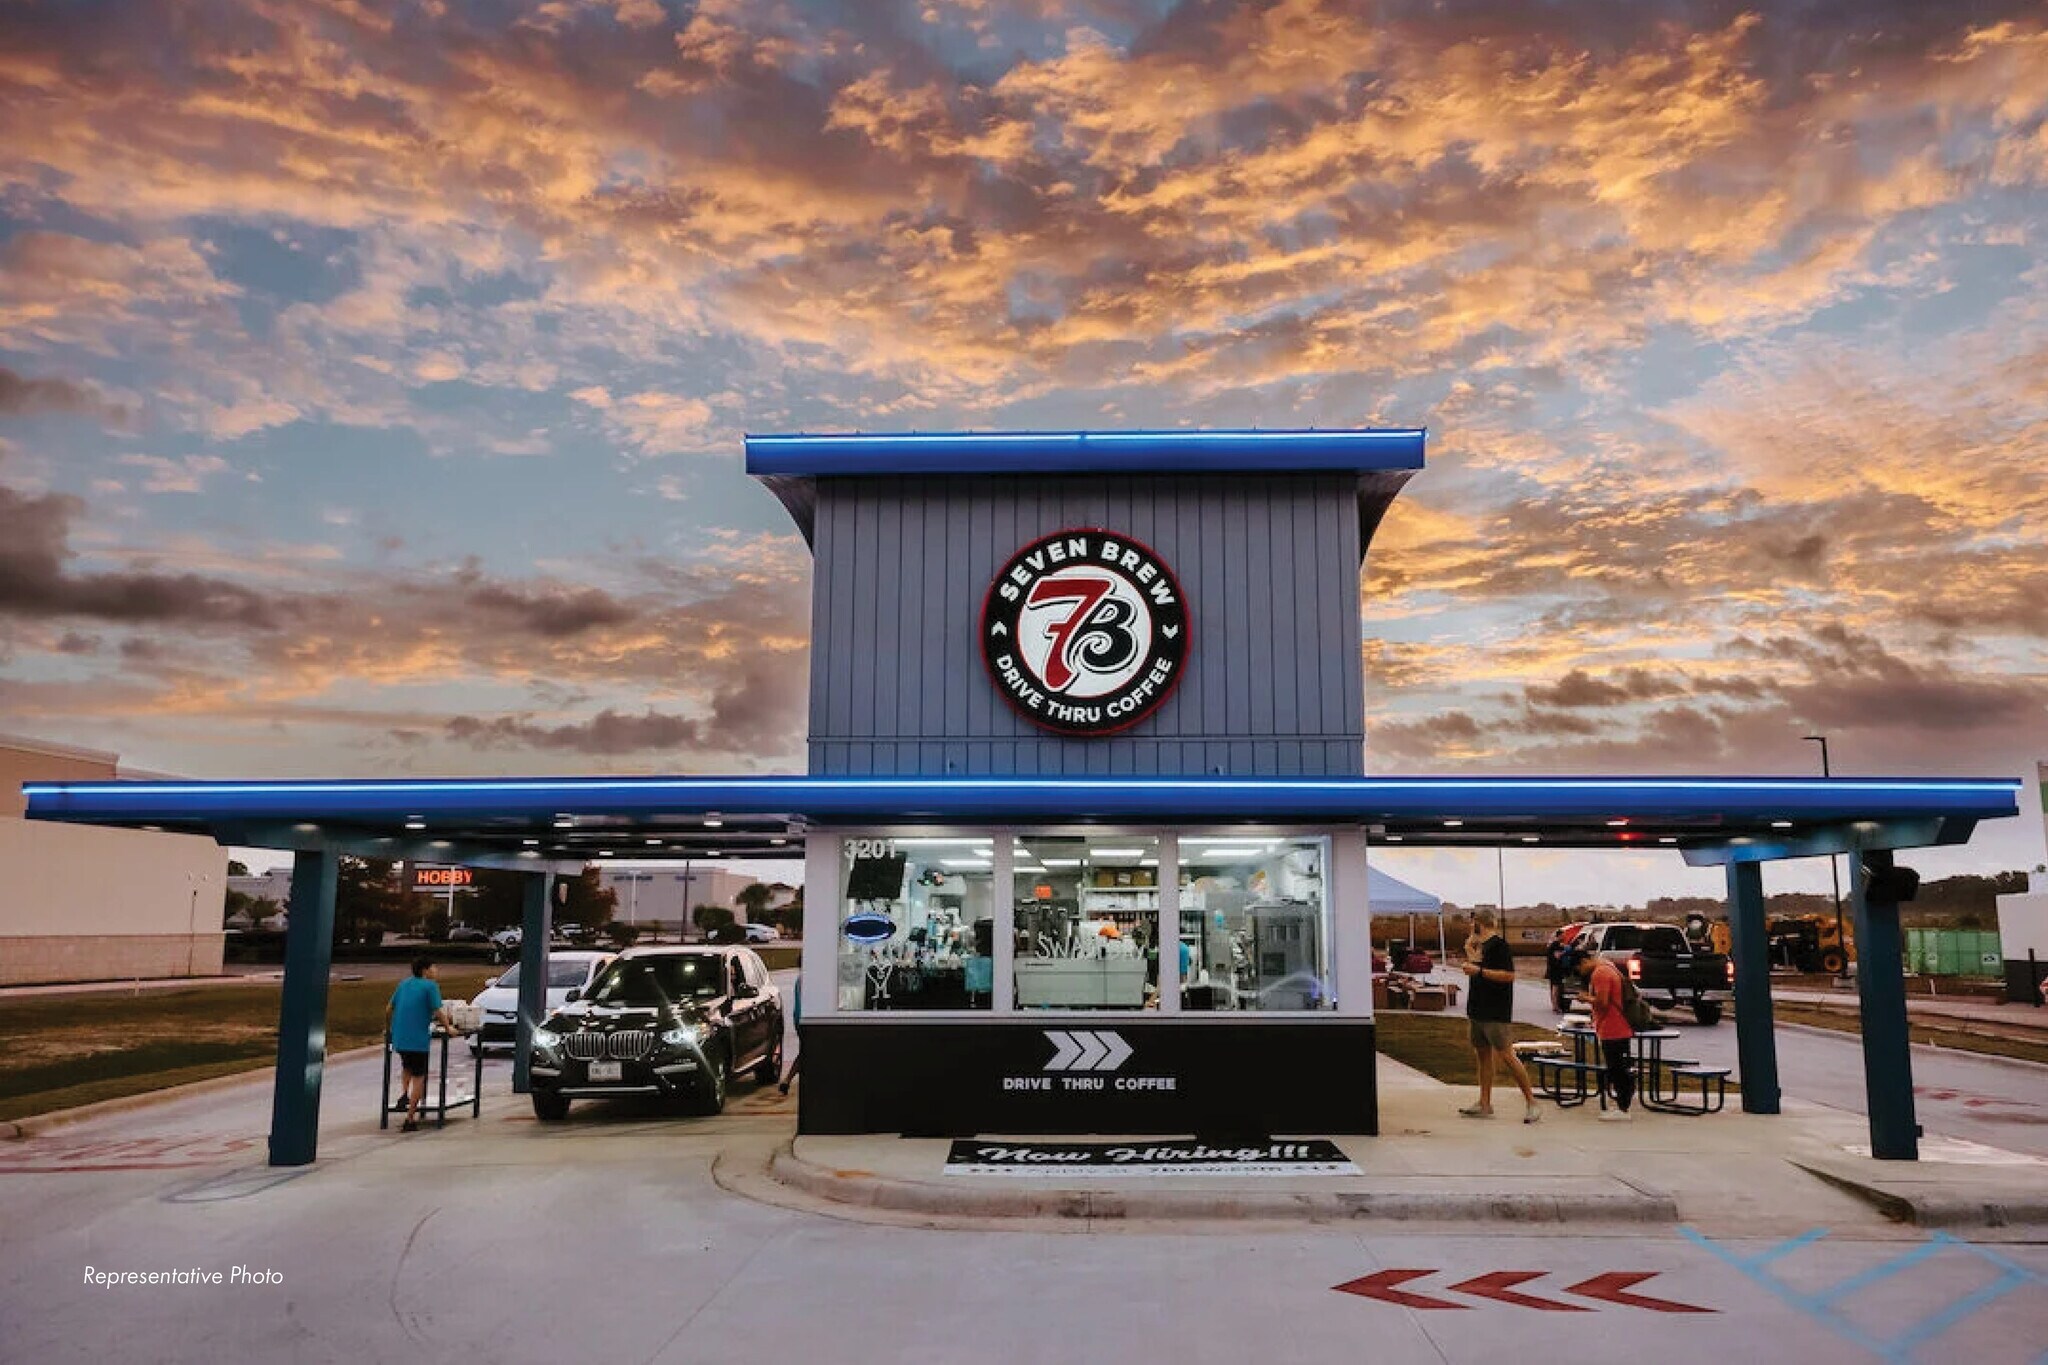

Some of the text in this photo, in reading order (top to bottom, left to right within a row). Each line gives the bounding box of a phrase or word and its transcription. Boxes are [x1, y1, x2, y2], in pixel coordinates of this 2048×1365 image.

[1000, 538, 1175, 605] SEVEN BREW
[997, 655, 1172, 722] DRIVE THRU COFFEE
[845, 839, 895, 859] 3201
[418, 870, 472, 884] HOBBY
[1003, 1077, 1176, 1090] DRIVE THRU COFFEE
[977, 1145, 1309, 1163] Now Hiring!!!
